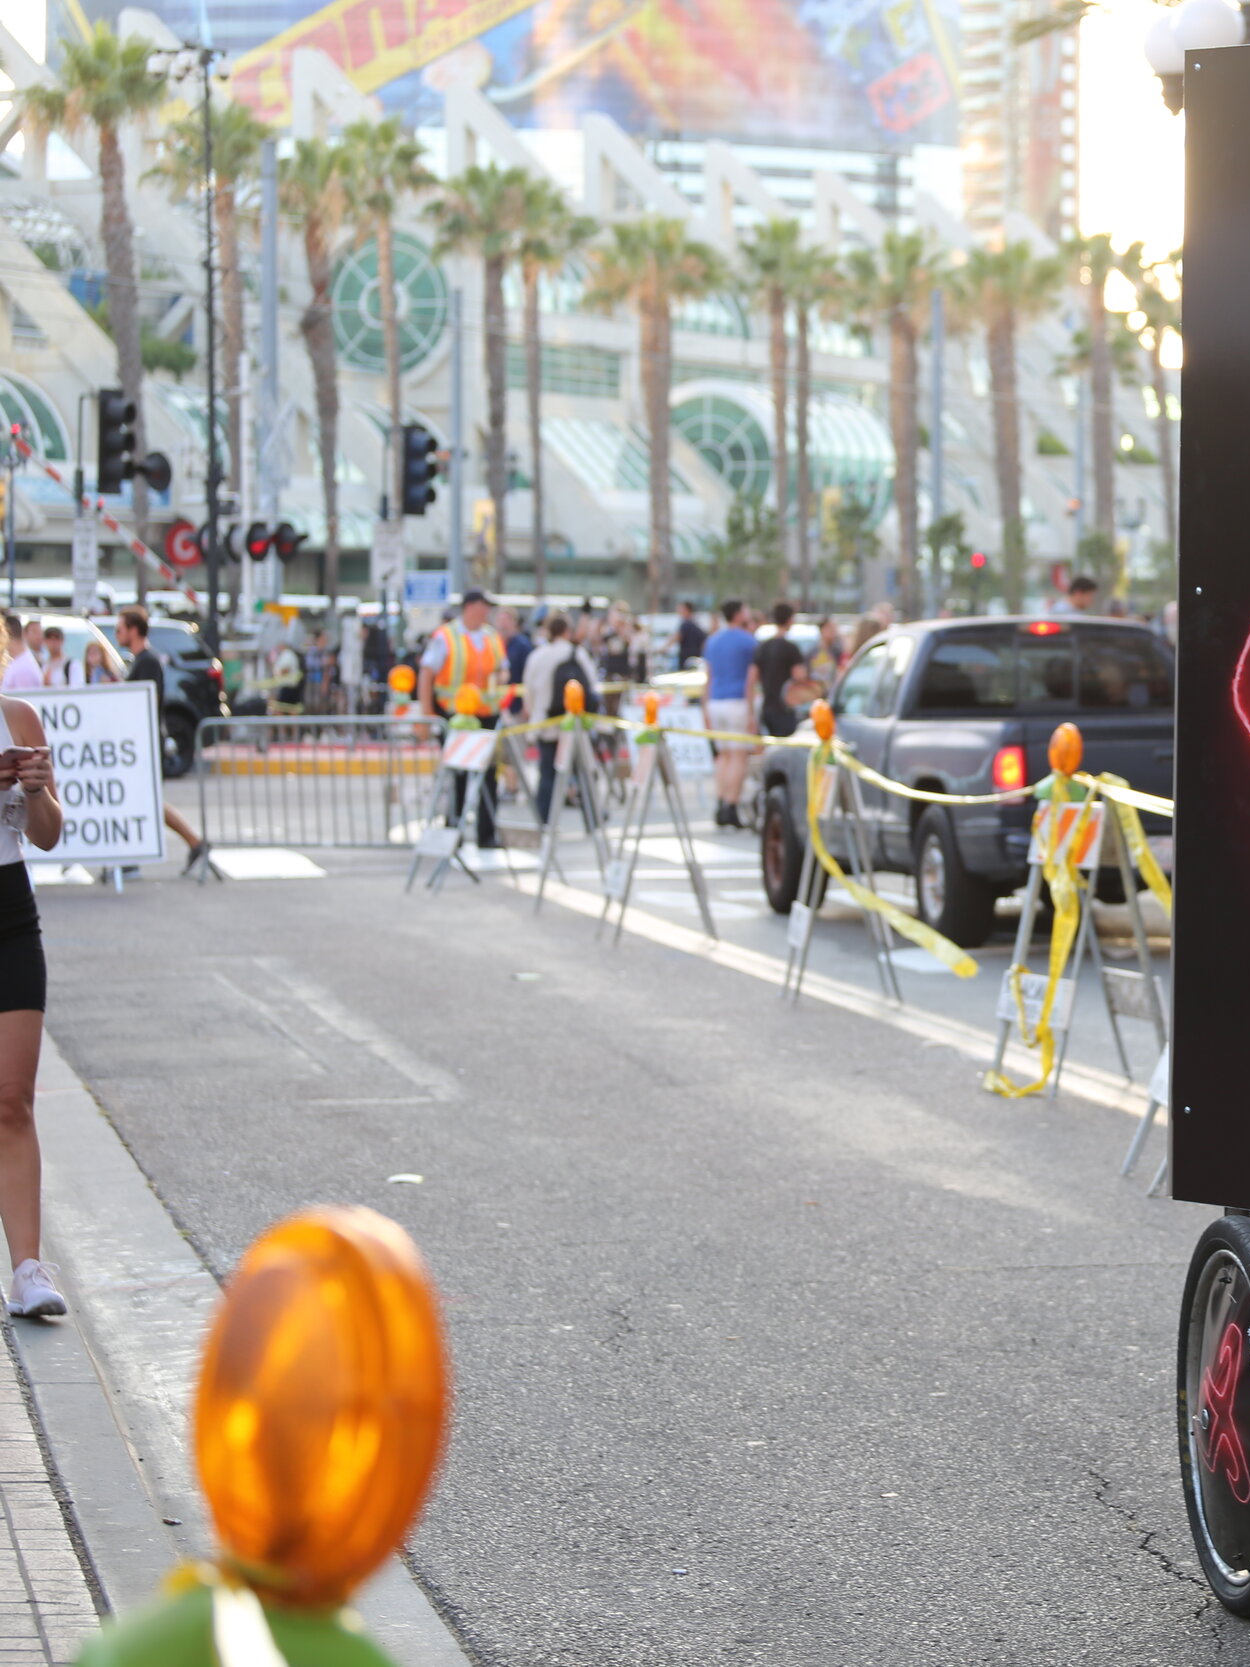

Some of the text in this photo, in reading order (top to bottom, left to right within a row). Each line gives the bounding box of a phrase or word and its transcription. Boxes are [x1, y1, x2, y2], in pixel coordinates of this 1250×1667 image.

[41, 704, 81, 731] NO
[51, 740, 137, 770] ICABS
[57, 779, 125, 807] OND
[63, 815, 147, 846] POINT
